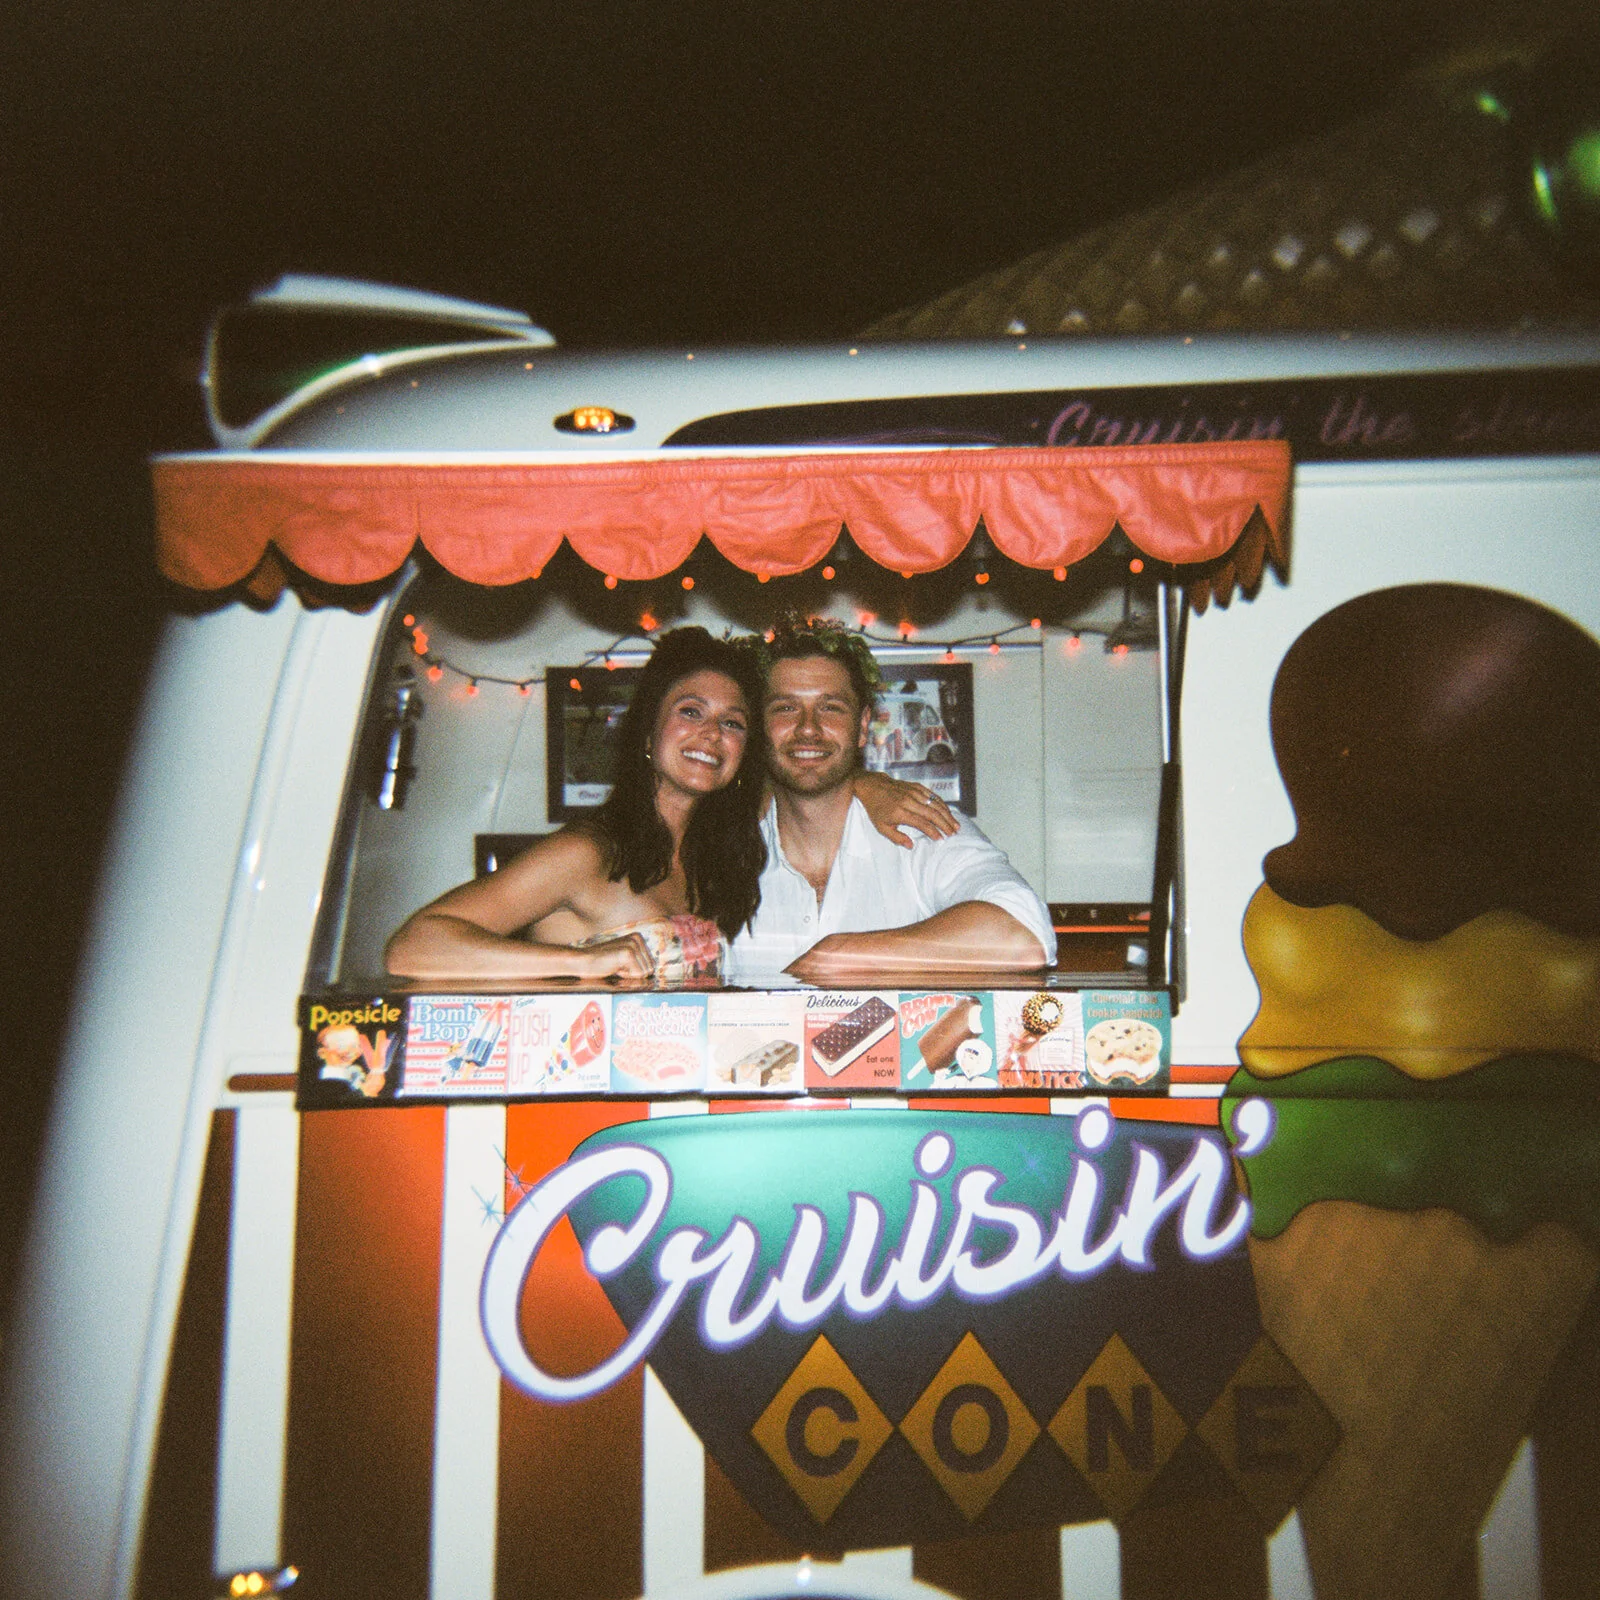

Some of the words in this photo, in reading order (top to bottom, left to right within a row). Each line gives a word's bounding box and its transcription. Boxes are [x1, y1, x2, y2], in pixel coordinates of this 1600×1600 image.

[1319, 393, 1415, 445] the
[806, 994, 861, 1009] Delicious
[899, 994, 956, 1018] BROWN
[1091, 991, 1136, 1004] Chocolate
[310, 1003, 401, 1030] Popsicle
[413, 1002, 480, 1023] Bomb
[615, 1000, 704, 1023] Strawberry
[901, 1008, 938, 1038] COW
[1087, 1008, 1118, 1018] Cookie
[1121, 1008, 1163, 1019] Sandwich
[420, 1022, 470, 1042] Pop
[511, 1012, 552, 1048] PUSH
[614, 1019, 698, 1040] Shortcake
[509, 1051, 531, 1086] UP
[866, 1055, 878, 1063] Eat
[873, 1068, 896, 1077] NOW
[477, 1096, 1277, 1403] Cruisin'
[784, 1384, 1300, 1477] CONE
